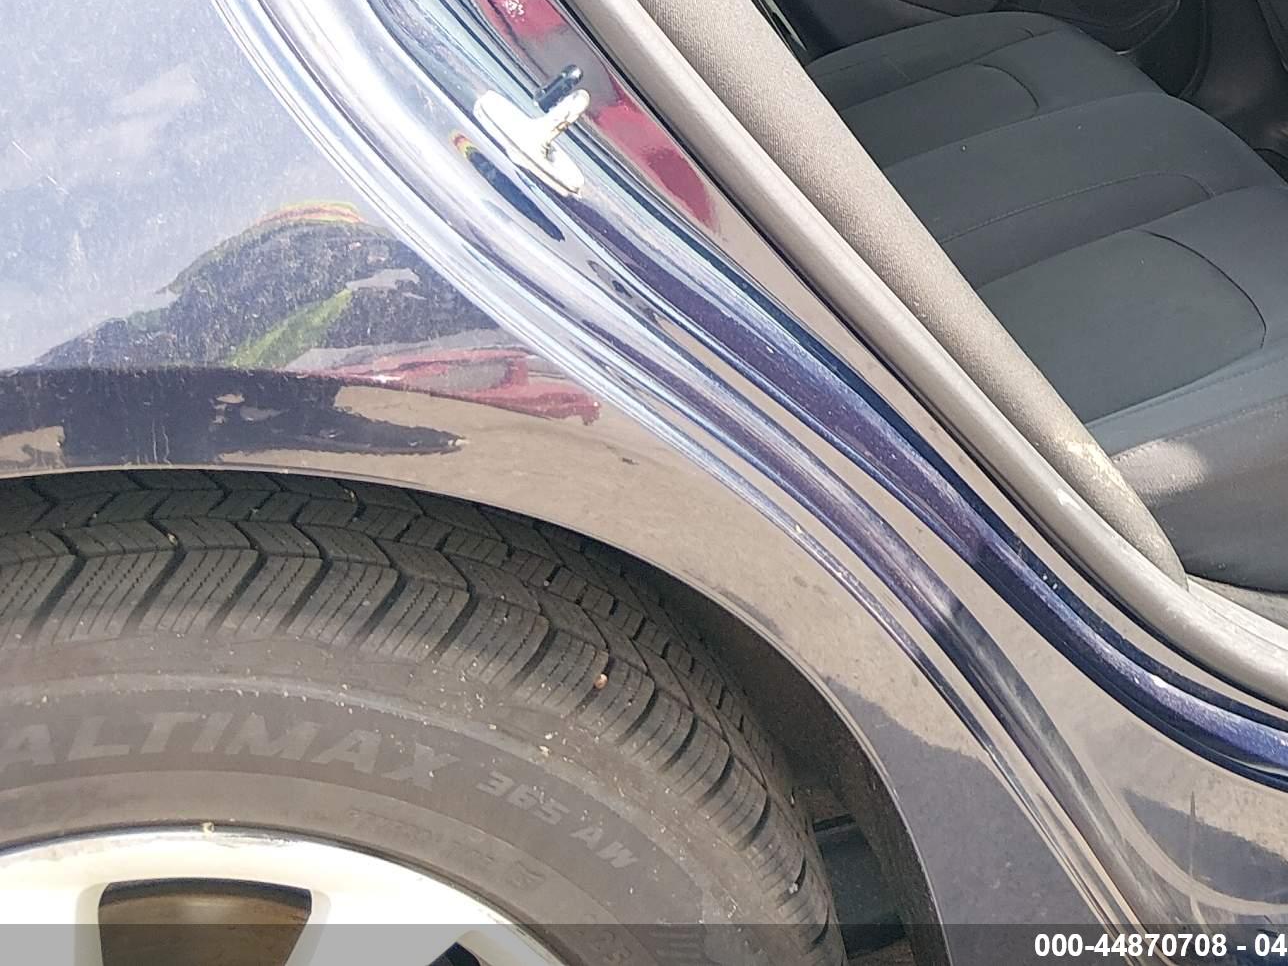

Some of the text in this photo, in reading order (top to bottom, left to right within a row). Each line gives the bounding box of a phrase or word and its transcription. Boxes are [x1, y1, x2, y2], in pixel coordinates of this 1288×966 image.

[0, 710, 461, 792] ALTIMAX
[475, 769, 571, 825] 365
[570, 826, 639, 869] AW
